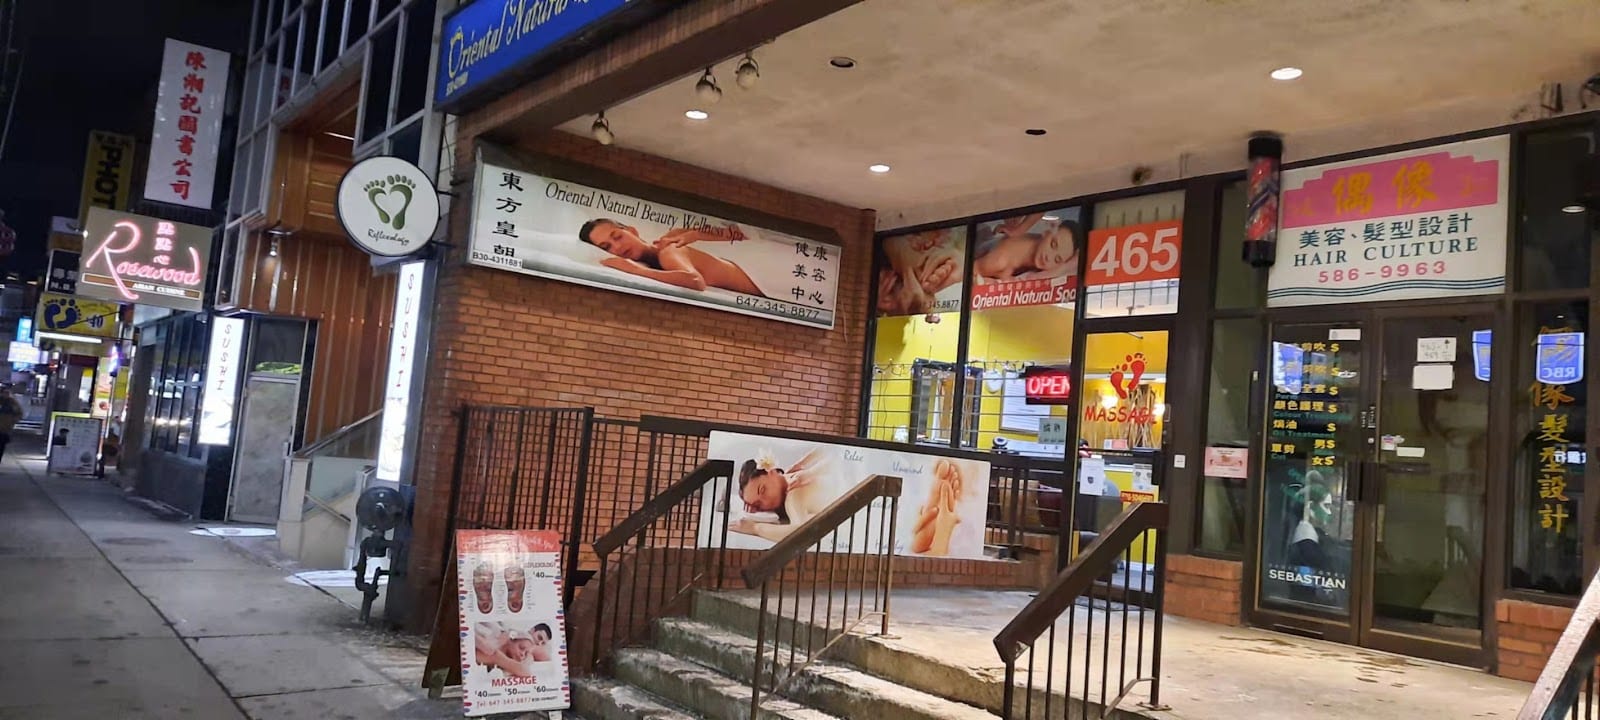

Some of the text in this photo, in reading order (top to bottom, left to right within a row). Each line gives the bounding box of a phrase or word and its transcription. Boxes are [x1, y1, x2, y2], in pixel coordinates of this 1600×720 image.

[545, 181, 746, 245] Oriental Natural Beauty Wellness Spa
[367, 228, 410, 246] Reflexology
[86, 220, 201, 300] Rosewood
[794, 242, 828, 261] 健康
[1091, 227, 1179, 277] 465
[1293, 236, 1479, 267] HAIR CULTURE
[792, 264, 827, 282] 美容
[1318, 260, 1446, 284] 586-9963
[132, 282, 186, 296] ASIAN CUISINE
[791, 286, 825, 305] 中心
[972, 290, 1013, 310] Oriental
[1013, 287, 1054, 305] Natural
[1056, 286, 1077, 305] Spa
[396, 273, 414, 387] SUSHI
[216, 324, 232, 390] SUSHI
[1027, 375, 1070, 395] OPEN
[1084, 405, 1158, 425] MASSAGE
[1269, 569, 1346, 589] SEBASTIAN
[491, 675, 537, 687] MASSAGE
